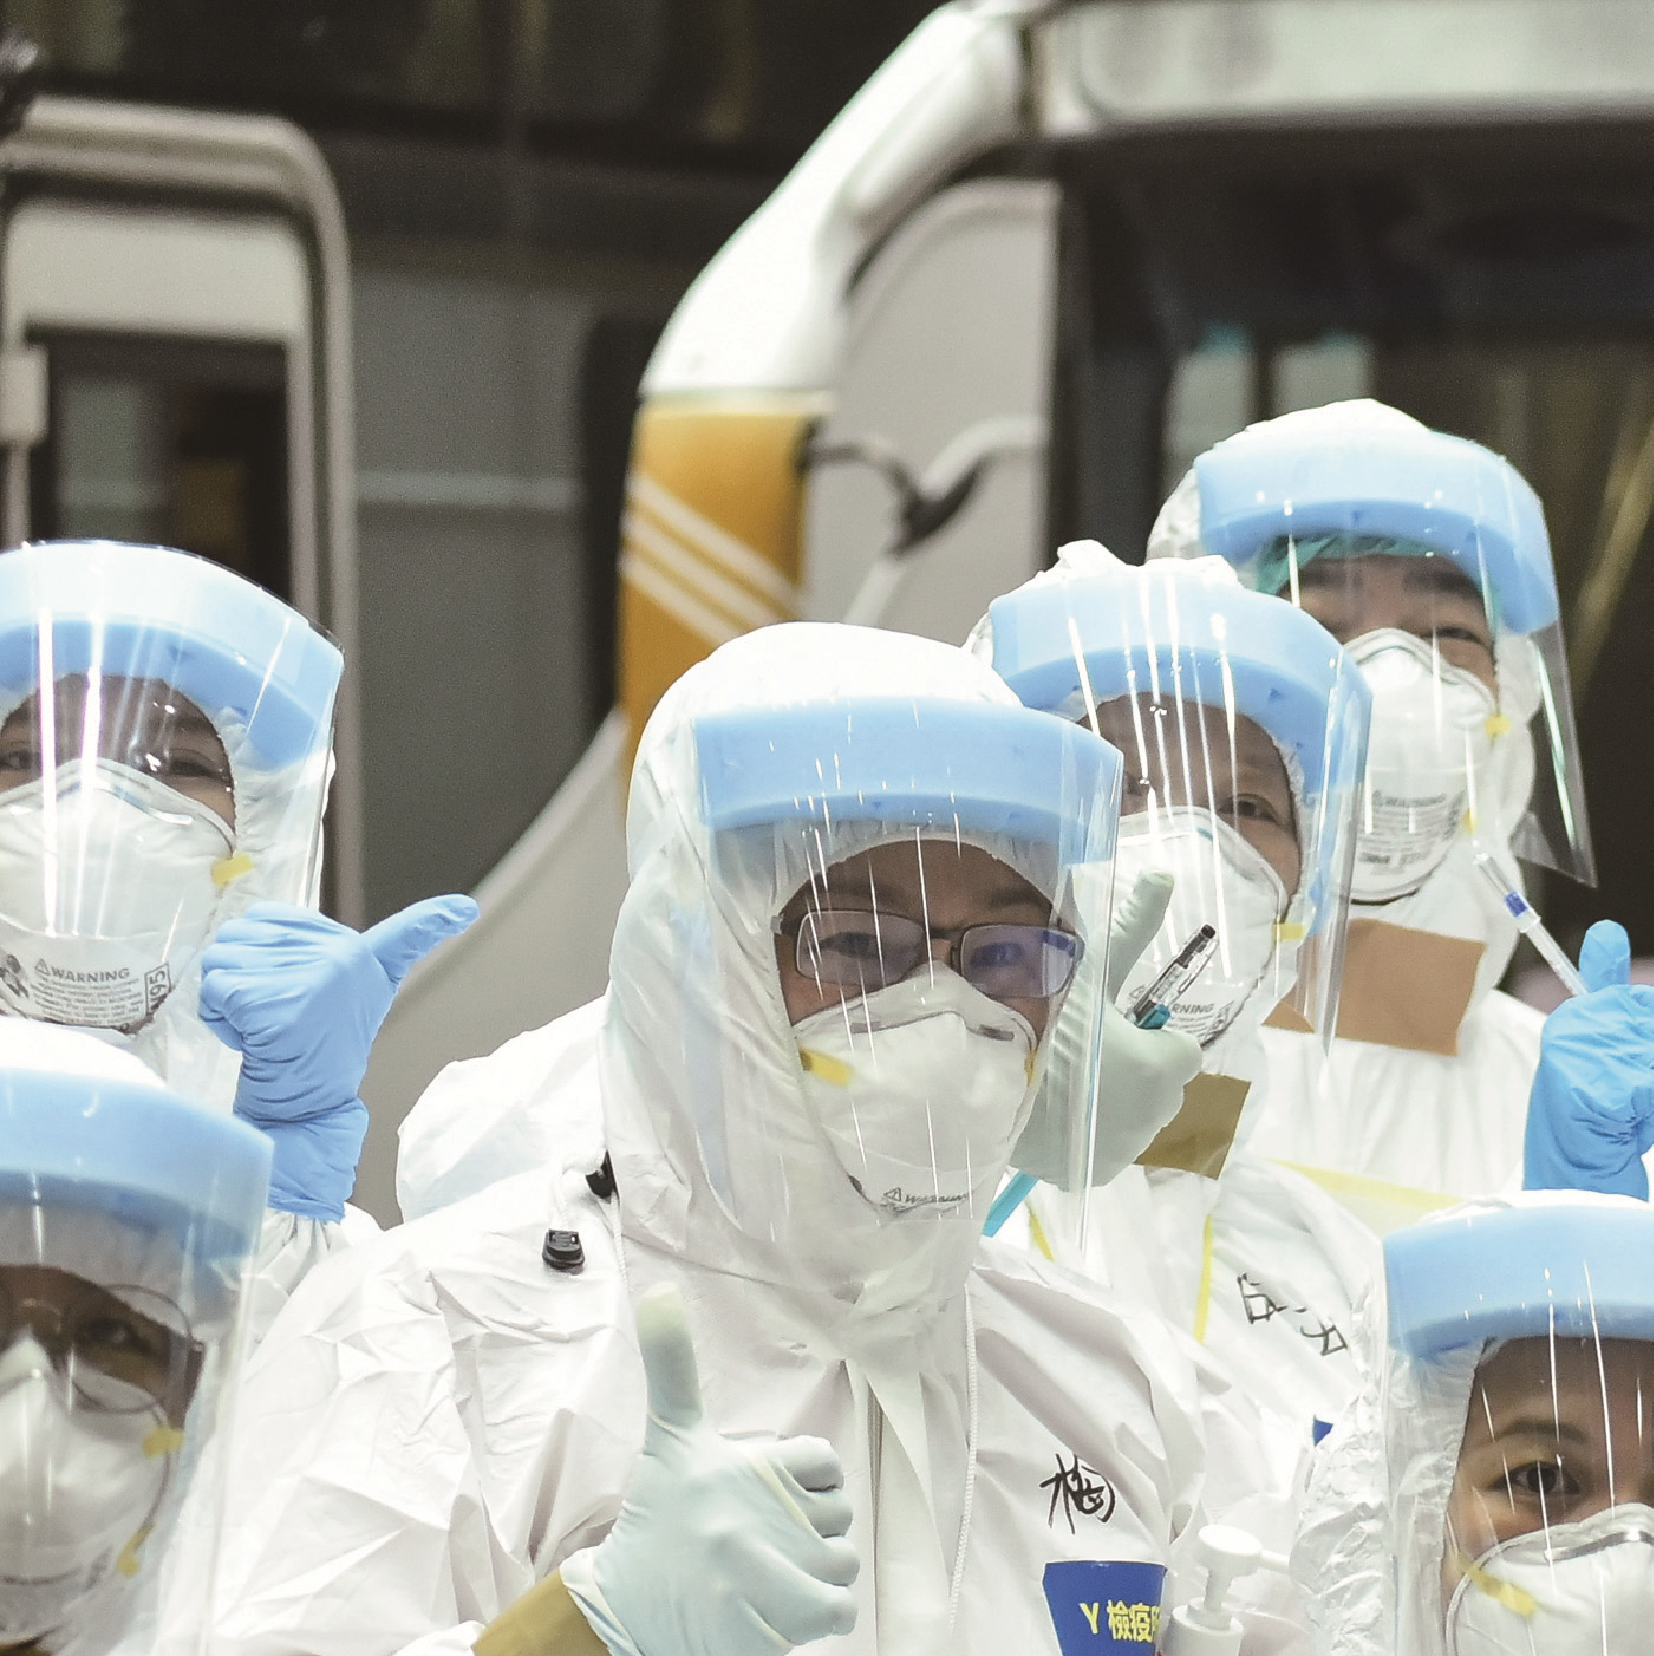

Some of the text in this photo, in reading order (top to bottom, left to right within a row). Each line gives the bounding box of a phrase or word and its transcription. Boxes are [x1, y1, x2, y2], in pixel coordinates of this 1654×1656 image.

[50, 968, 131, 984] WARNING
[1171, 1003, 1215, 1015] RNING
[1079, 1602, 1100, 1634] Y
